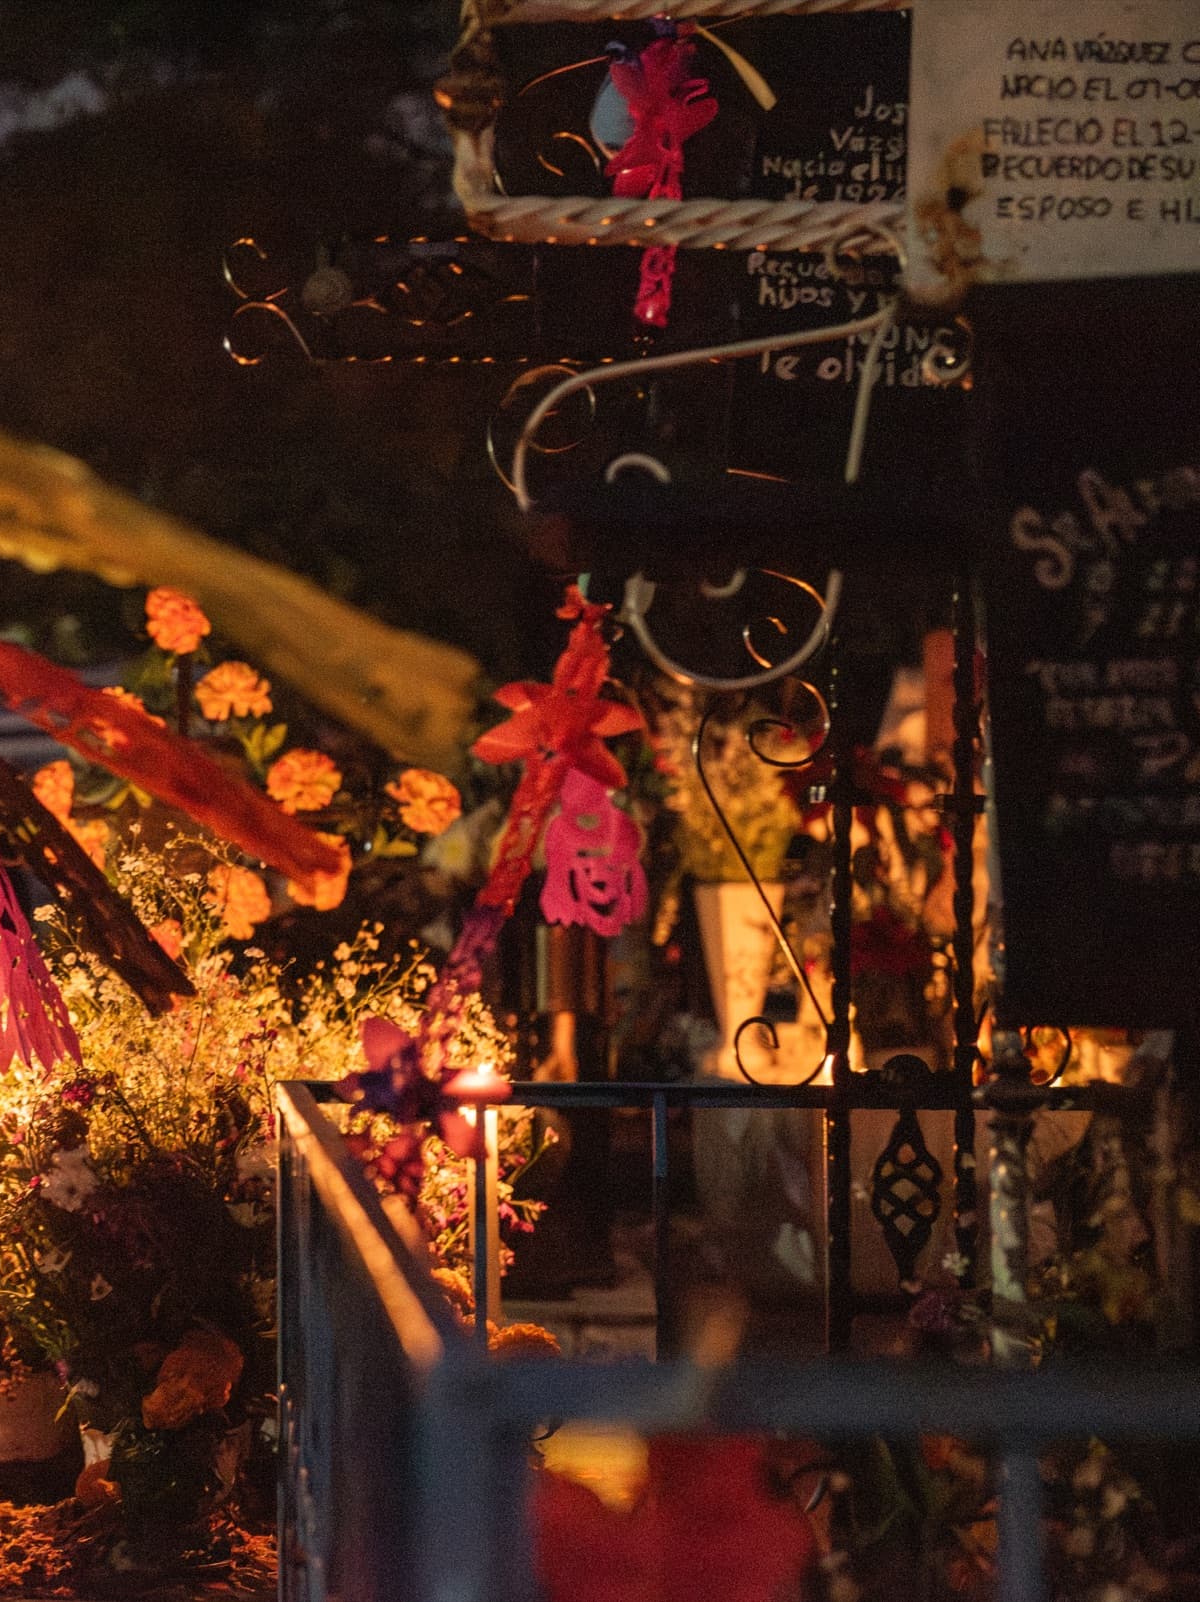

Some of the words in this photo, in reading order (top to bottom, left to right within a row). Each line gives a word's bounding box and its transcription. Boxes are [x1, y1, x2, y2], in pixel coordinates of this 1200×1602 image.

[1006, 36, 1067, 61] ANA
[1000, 74, 1077, 101] NACIO
[1083, 77, 1118, 101] EL
[982, 115, 1103, 147] FALLECIO
[1112, 118, 1144, 148] EL
[980, 153, 1123, 181] RECUERDO
[1127, 154, 1157, 181] DE
[1159, 155, 1197, 181] SU
[995, 194, 1112, 221] ESPOSO
[1126, 198, 1146, 221] E
